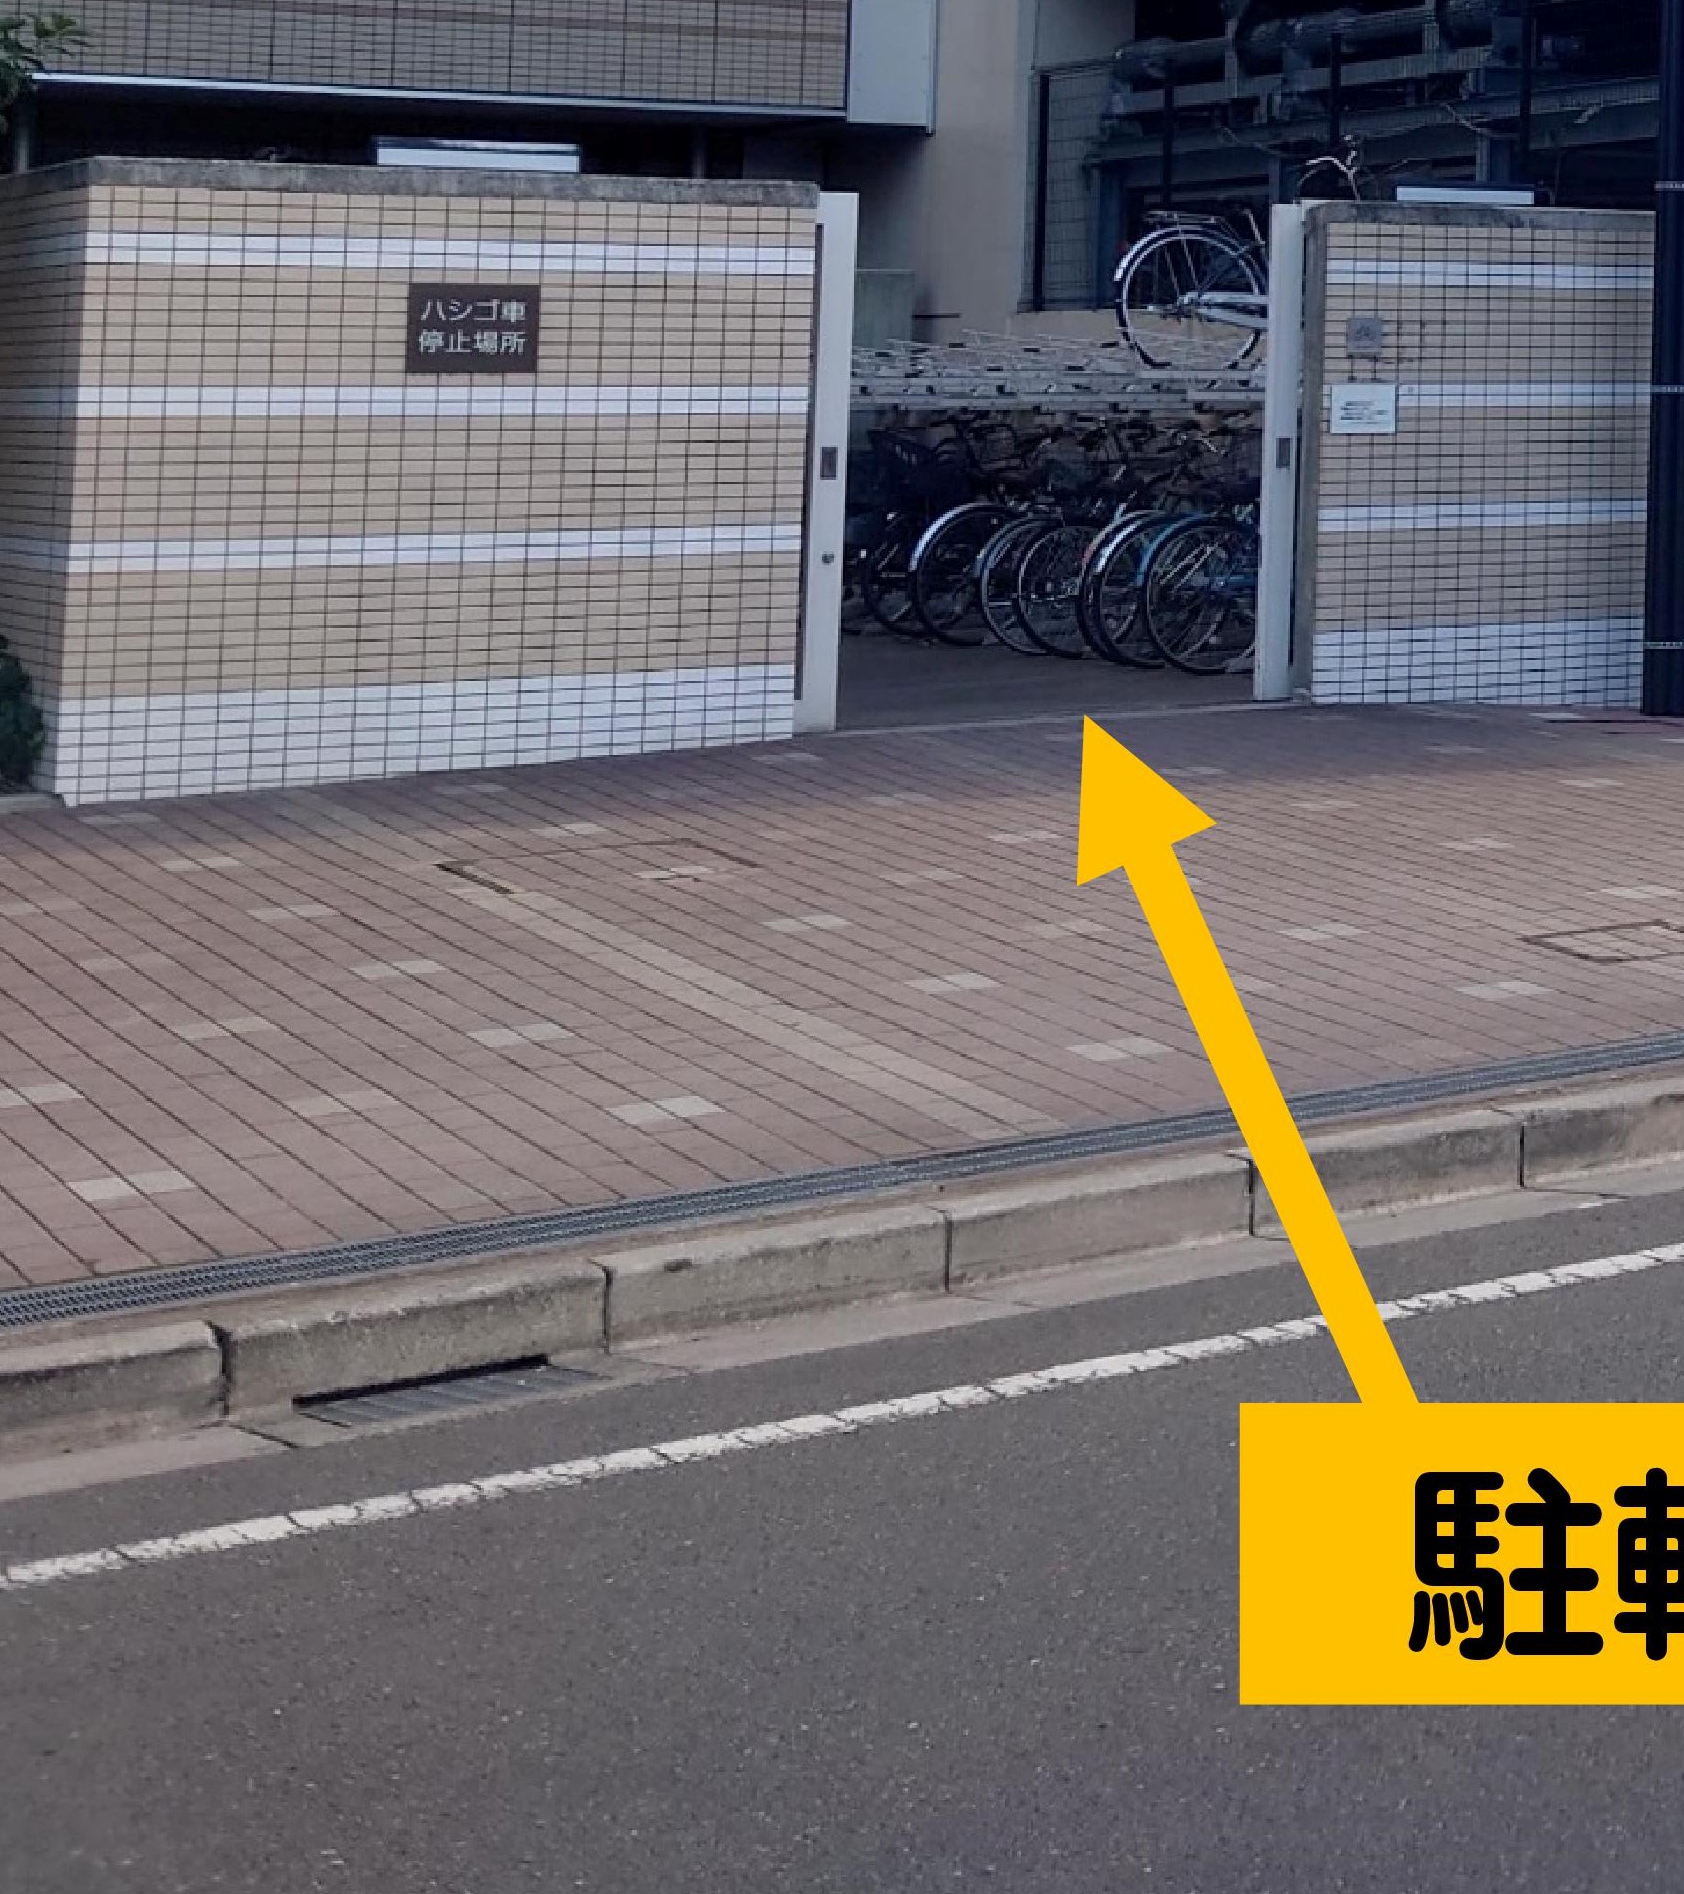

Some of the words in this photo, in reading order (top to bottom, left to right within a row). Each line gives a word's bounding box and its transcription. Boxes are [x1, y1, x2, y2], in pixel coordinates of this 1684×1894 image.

[420, 298, 526, 323] ハシゴ車
[418, 328, 527, 356] 停止場所
